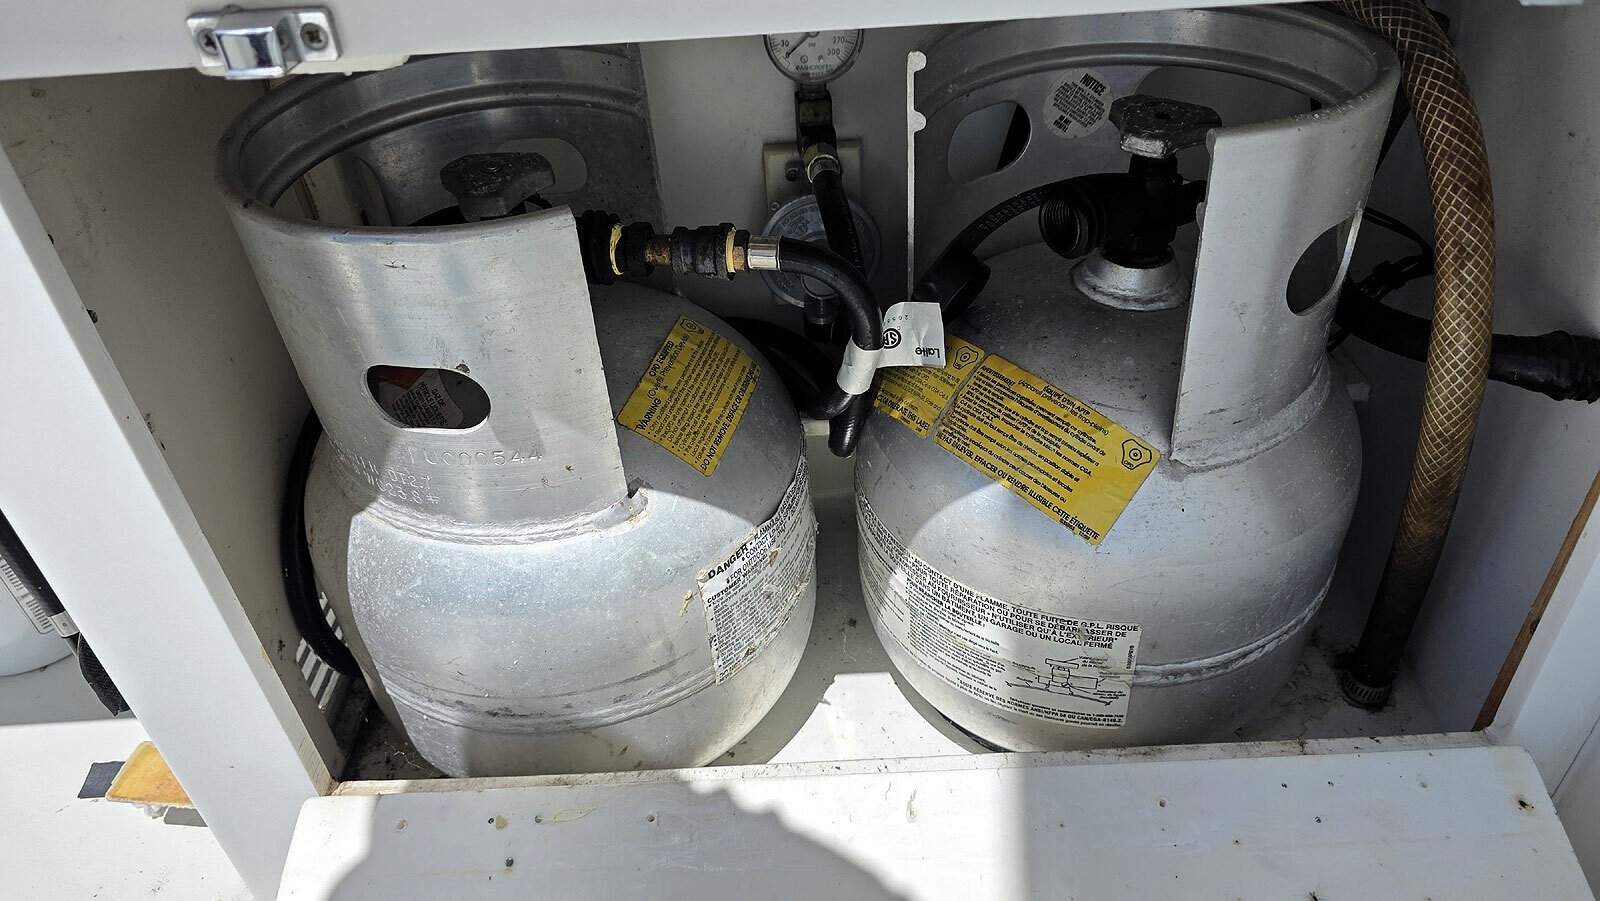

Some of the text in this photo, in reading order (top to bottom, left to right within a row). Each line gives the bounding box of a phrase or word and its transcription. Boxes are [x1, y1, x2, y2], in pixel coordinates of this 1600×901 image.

[1080, 73, 1106, 96] NOTICE
[648, 340, 674, 378] OPD EQUIPPED
[659, 349, 681, 377] Prevention
[431, 388, 440, 400] GAZ
[1042, 383, 1064, 401] ÉQUIPÉ
[1061, 396, 1077, 408] D'UN
[636, 396, 662, 430] WARNING
[699, 458, 710, 470] DO
[705, 444, 717, 459] NOT
[725, 401, 739, 422] DEFACE
[734, 394, 742, 404] OR
[951, 440, 974, 459] ENLEVER,
[973, 454, 998, 473] EFFACER
[997, 469, 1008, 479] OU
[1006, 475, 1030, 494] RENDRE
[1027, 489, 1054, 509] ILLISIBLE
[1051, 505, 1071, 521] CETTE
[1069, 515, 1100, 540] ÉTIQUETTE
[707, 542, 751, 580] DANGER
[729, 567, 743, 582] FOR
[742, 546, 768, 571] OUTDOOR
[766, 536, 778, 549] USE
[744, 533, 770, 559] CONTACT
[707, 576, 741, 604] CUSTOMER
[910, 561, 930, 576] POUR
[928, 574, 950, 591] TOUTE
[950, 587, 995, 612] RÉPARATION
[996, 608, 1008, 616] OU
[1009, 612, 1034, 624] POUR
[1034, 619, 1047, 627] SE
[1047, 620, 1113, 635] DÉBARSSER
[912, 558, 923, 567] AU
[921, 564, 953, 586] CONTACT
[953, 582, 975, 598] D'UNE
[1011, 606, 1039, 619] TOUTE
[1040, 614, 1068, 626] FUITE
[944, 603, 951, 611] LA
[912, 577, 931, 592] DANS
[931, 588, 941, 598] UN
[940, 595, 976, 618] BÂTIMENT,
[977, 614, 988, 622] UN
[989, 618, 1024, 634] GARAGE
[1025, 630, 1038, 638] OU
[1039, 633, 1051, 641] UN
[1053, 634, 1082, 646] LOCAL
[927, 580, 1117, 641] AU FOURNISSEUR N'UTILISER QU'À L'EXRIEUR
[1006, 700, 1029, 710] NORMES
